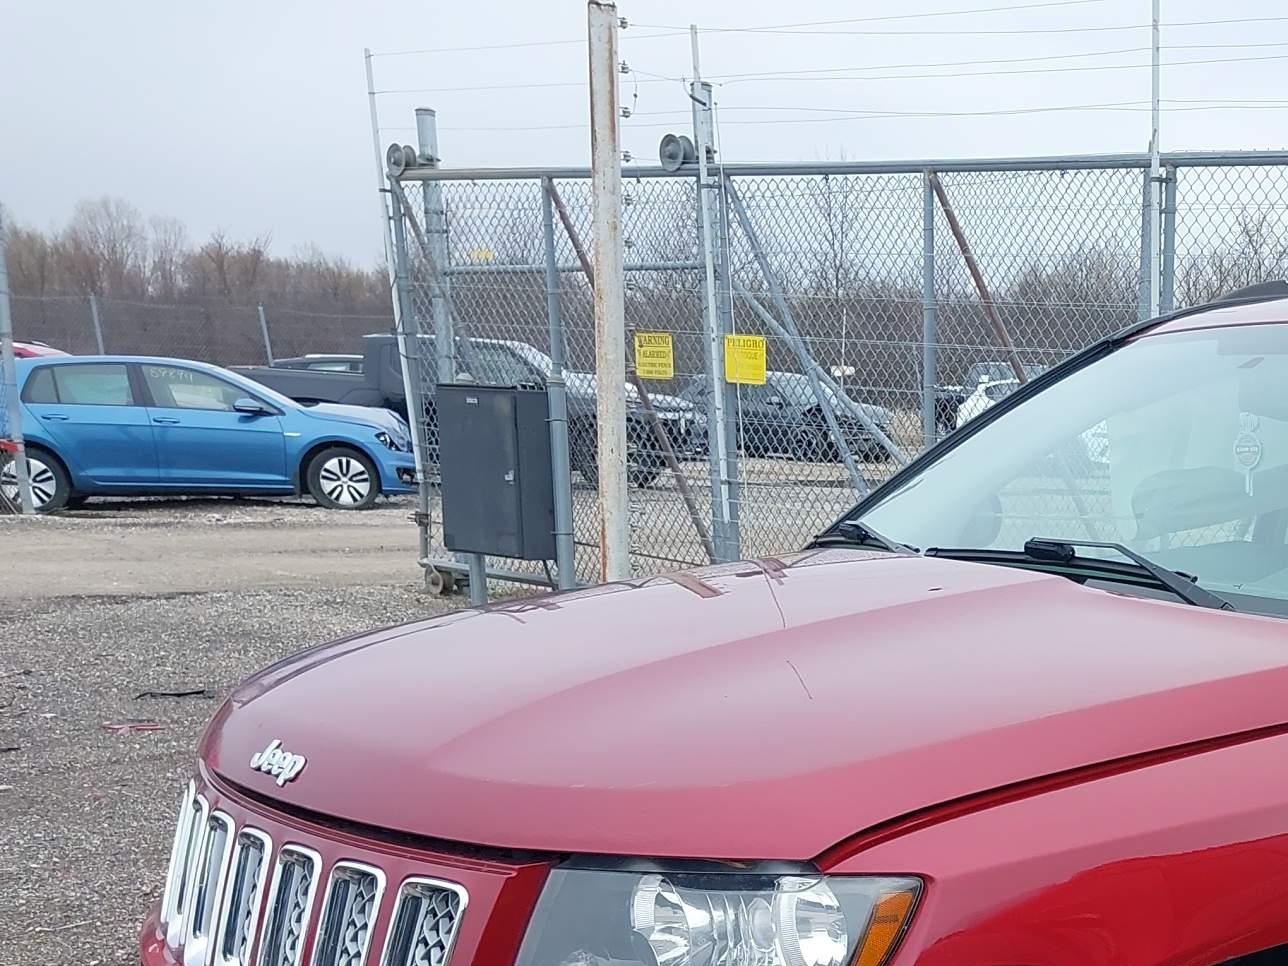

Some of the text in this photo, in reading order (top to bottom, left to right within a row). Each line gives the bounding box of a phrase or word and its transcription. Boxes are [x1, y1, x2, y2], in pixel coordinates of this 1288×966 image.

[637, 335, 670, 346] WARNING
[727, 338, 764, 349] PELIGRO
[249, 738, 307, 787] Jeep
